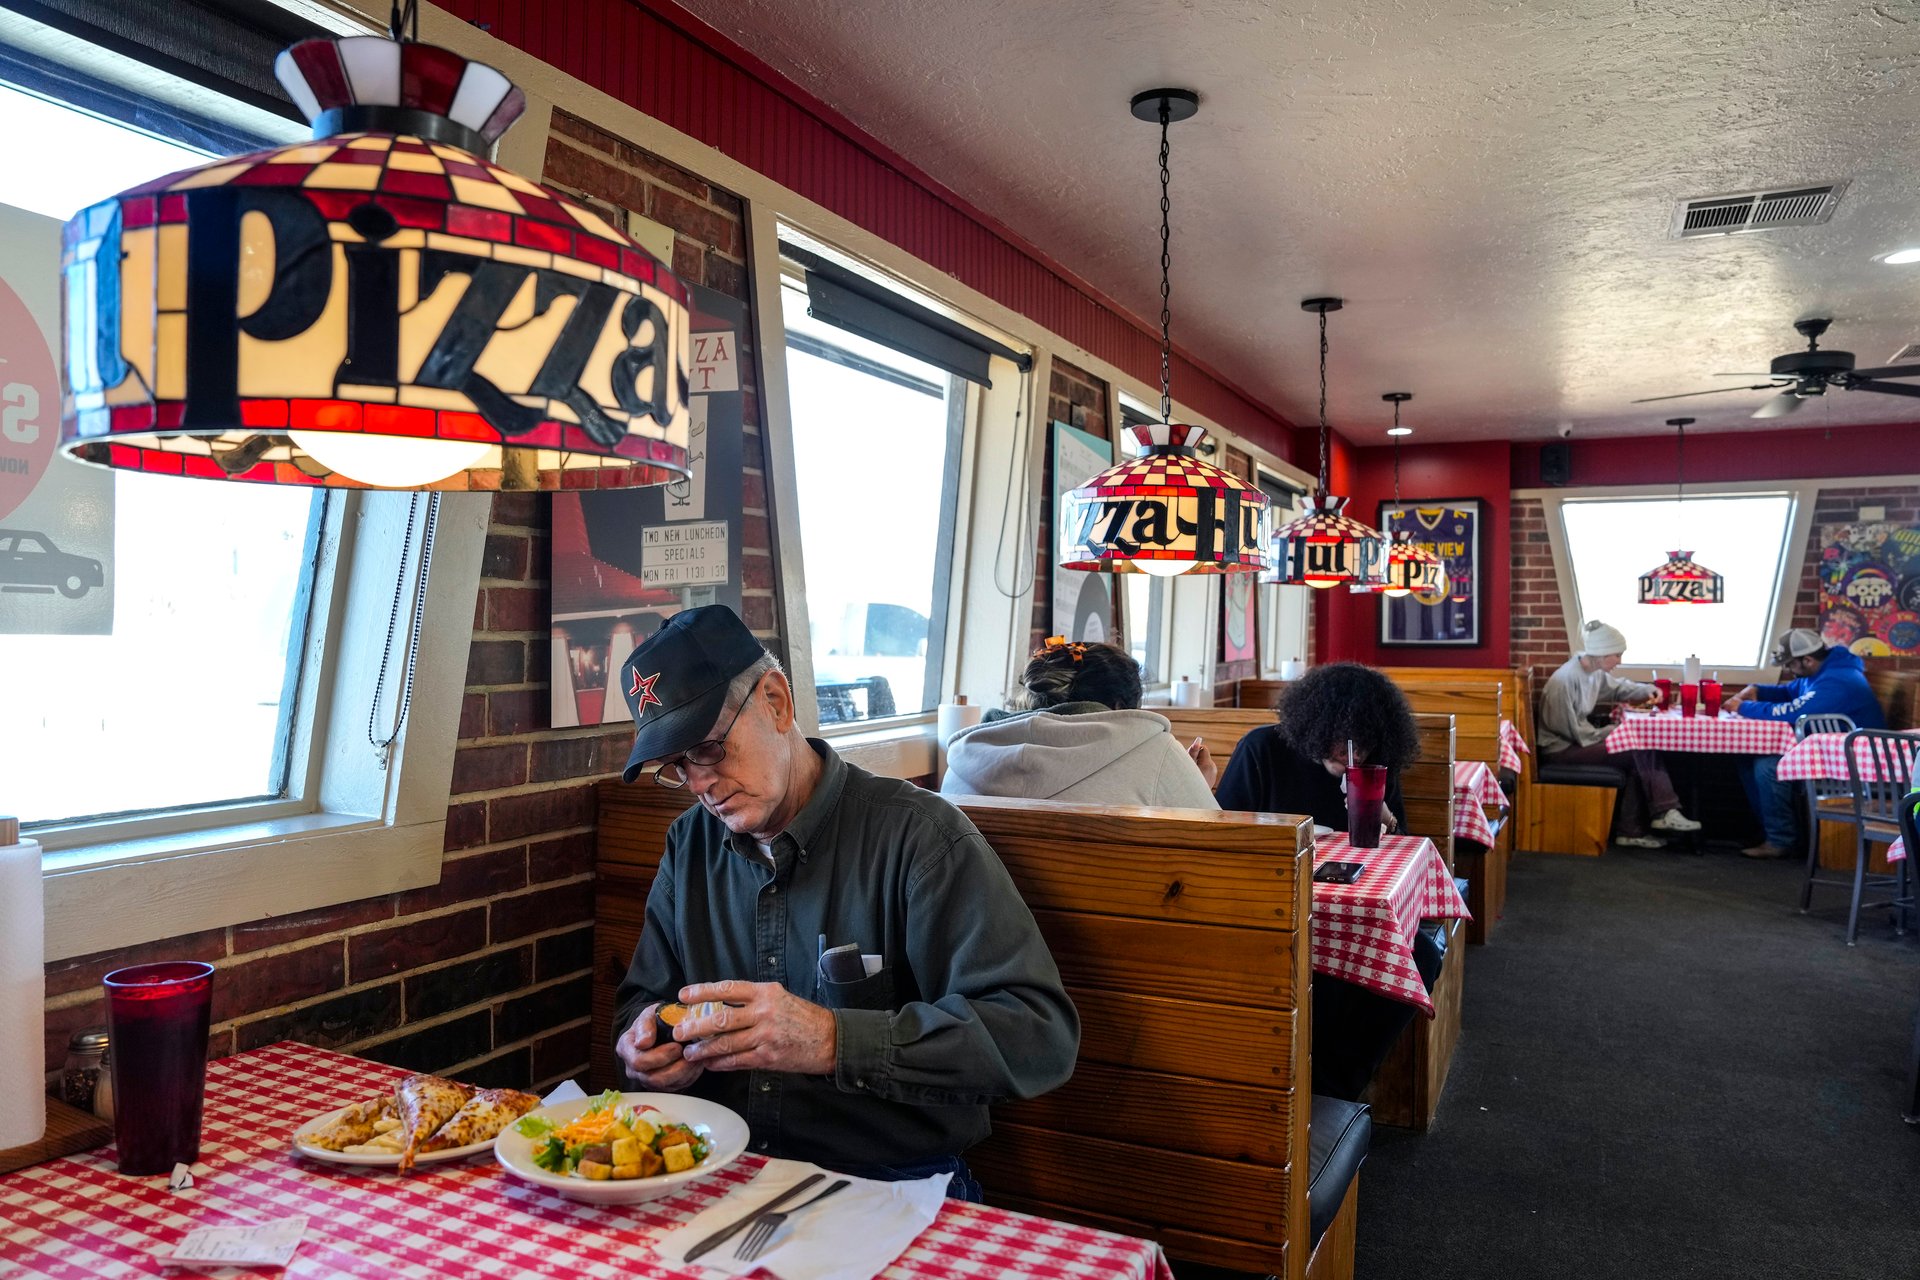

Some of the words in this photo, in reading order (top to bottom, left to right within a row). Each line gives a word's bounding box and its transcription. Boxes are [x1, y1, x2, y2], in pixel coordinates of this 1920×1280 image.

[186, 188, 675, 446] Pizza
[644, 530, 659, 543] TWO
[664, 528, 680, 541] NEW
[685, 526, 725, 541] LUNCHEON
[664, 546, 705, 561] SPECIALS
[1438, 541, 1465, 556] VIEW
[643, 569, 659, 582] MON
[664, 567, 679, 581] FRI
[686, 566, 705, 579] 1130
[711, 564, 726, 578] 130
[1641, 576, 1705, 602] Pizza
[1847, 578, 1892, 597] BOOK
